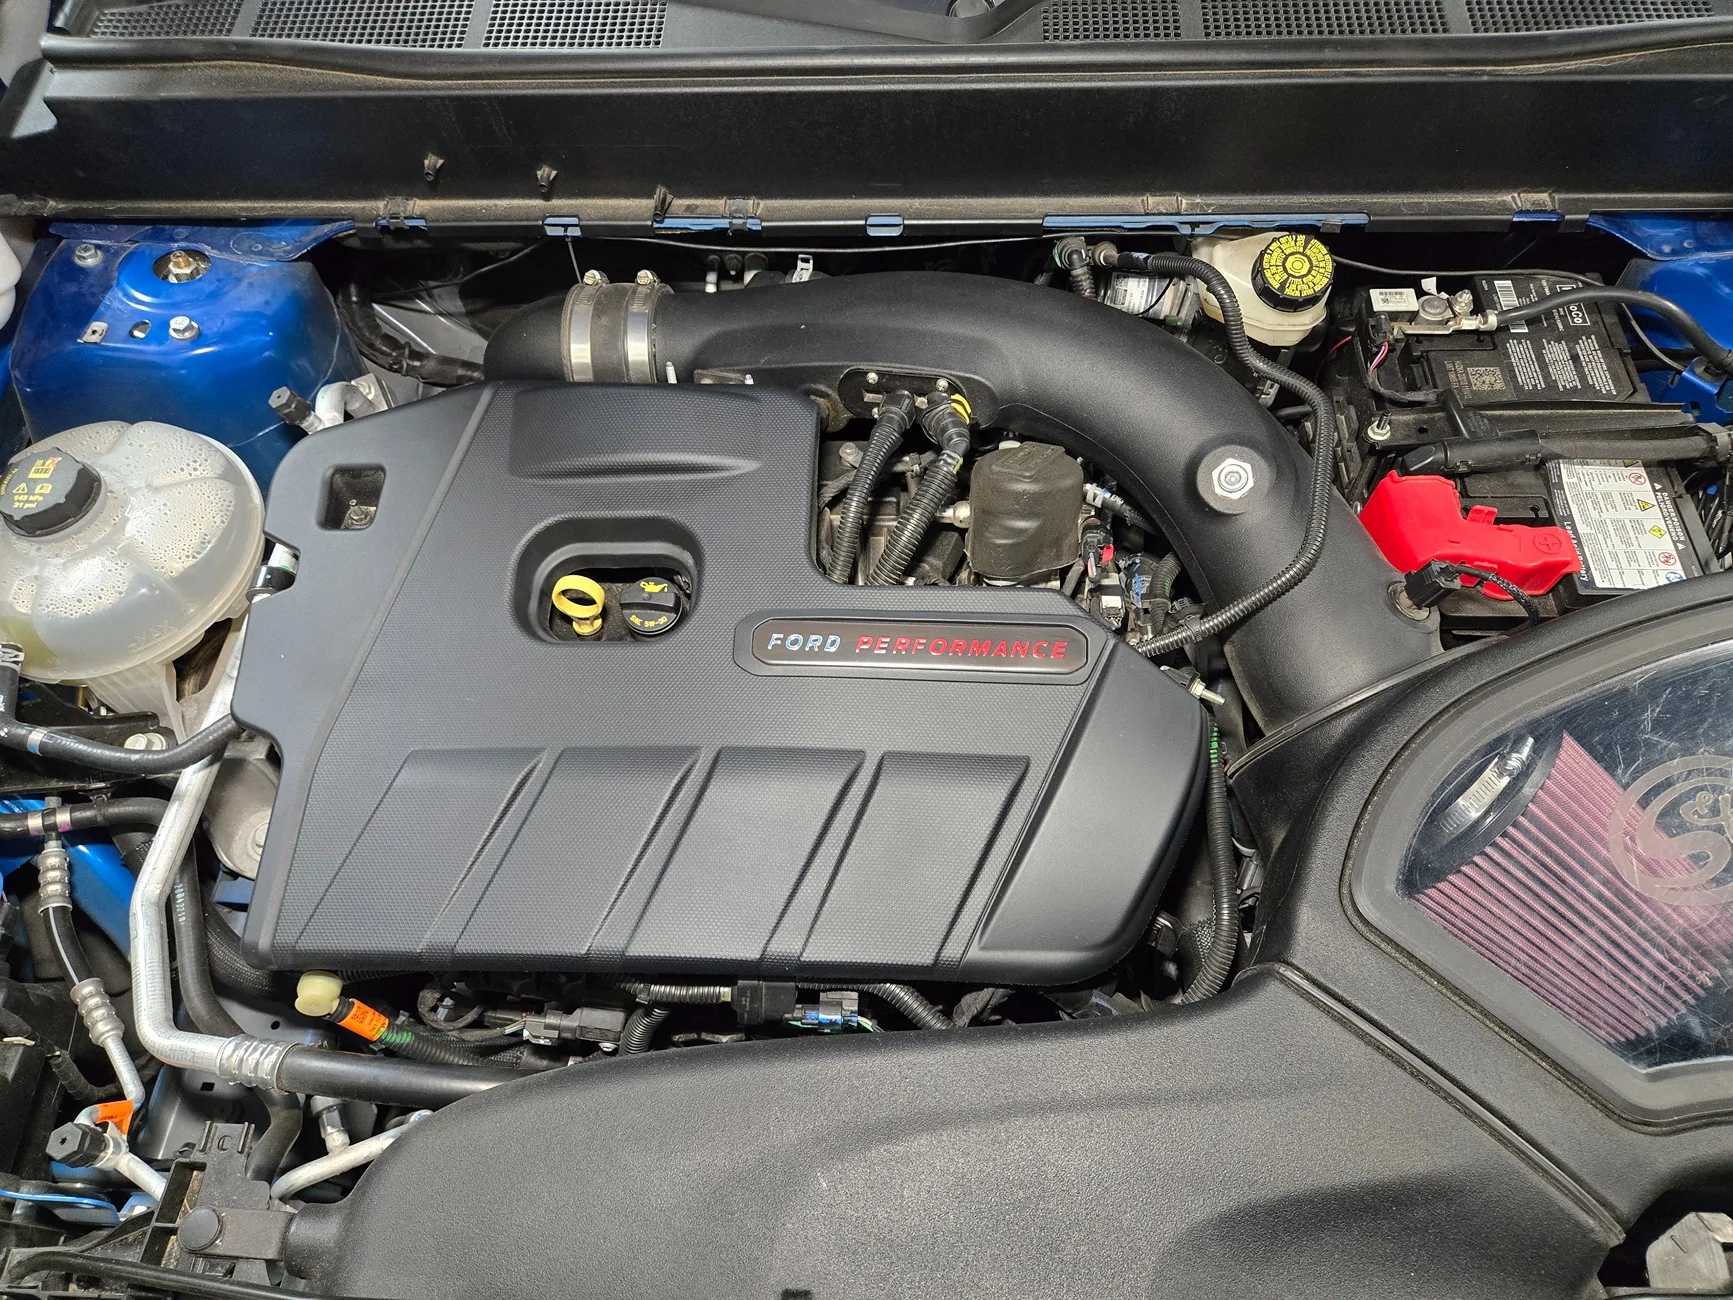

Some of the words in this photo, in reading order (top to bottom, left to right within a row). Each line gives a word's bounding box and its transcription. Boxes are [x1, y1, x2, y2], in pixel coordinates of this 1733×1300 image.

[629, 614, 644, 626] SAE
[644, 616, 668, 628] 5W-30
[767, 633, 842, 653] FORD
[855, 636, 1069, 660] PERFORMANCE
